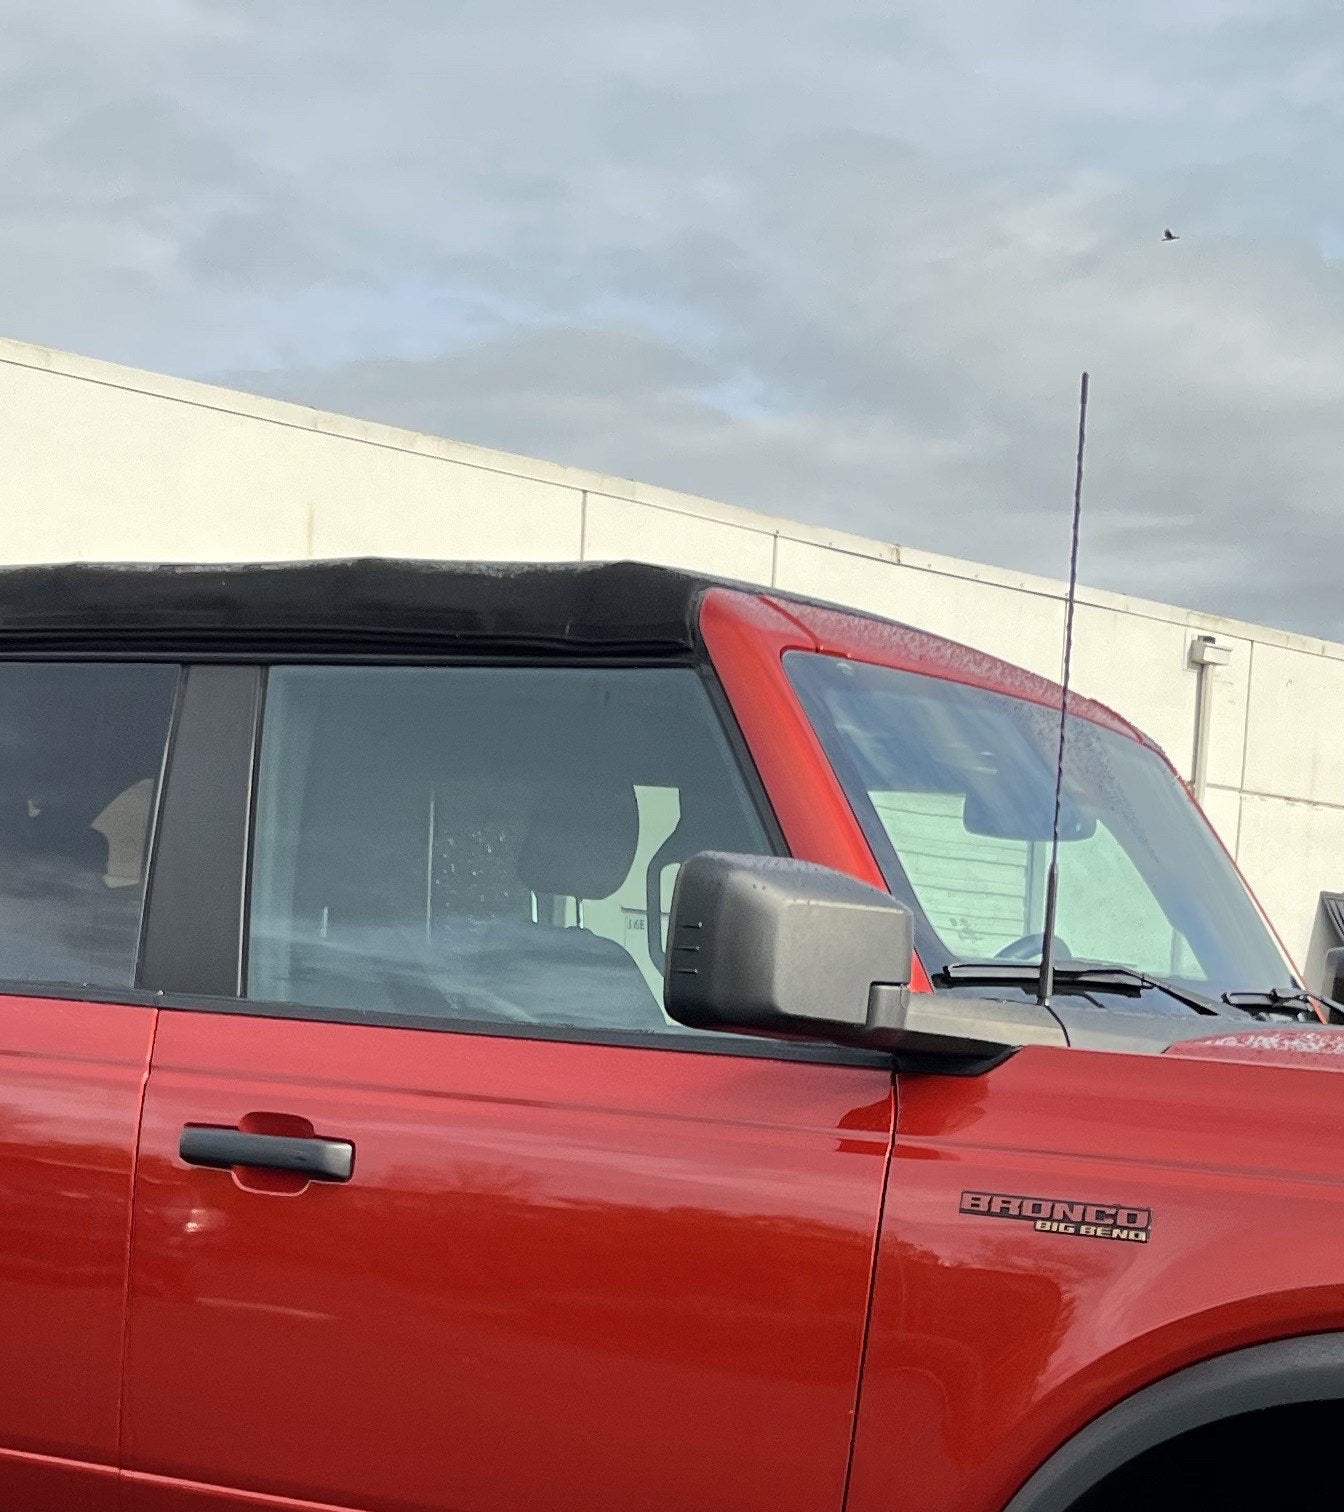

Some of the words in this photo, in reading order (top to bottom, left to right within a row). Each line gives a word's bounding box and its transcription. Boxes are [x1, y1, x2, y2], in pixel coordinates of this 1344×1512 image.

[959, 1191, 1150, 1229] BRONCO
[1035, 1219, 1076, 1235] BIG
[1078, 1224, 1147, 1242] BEND
